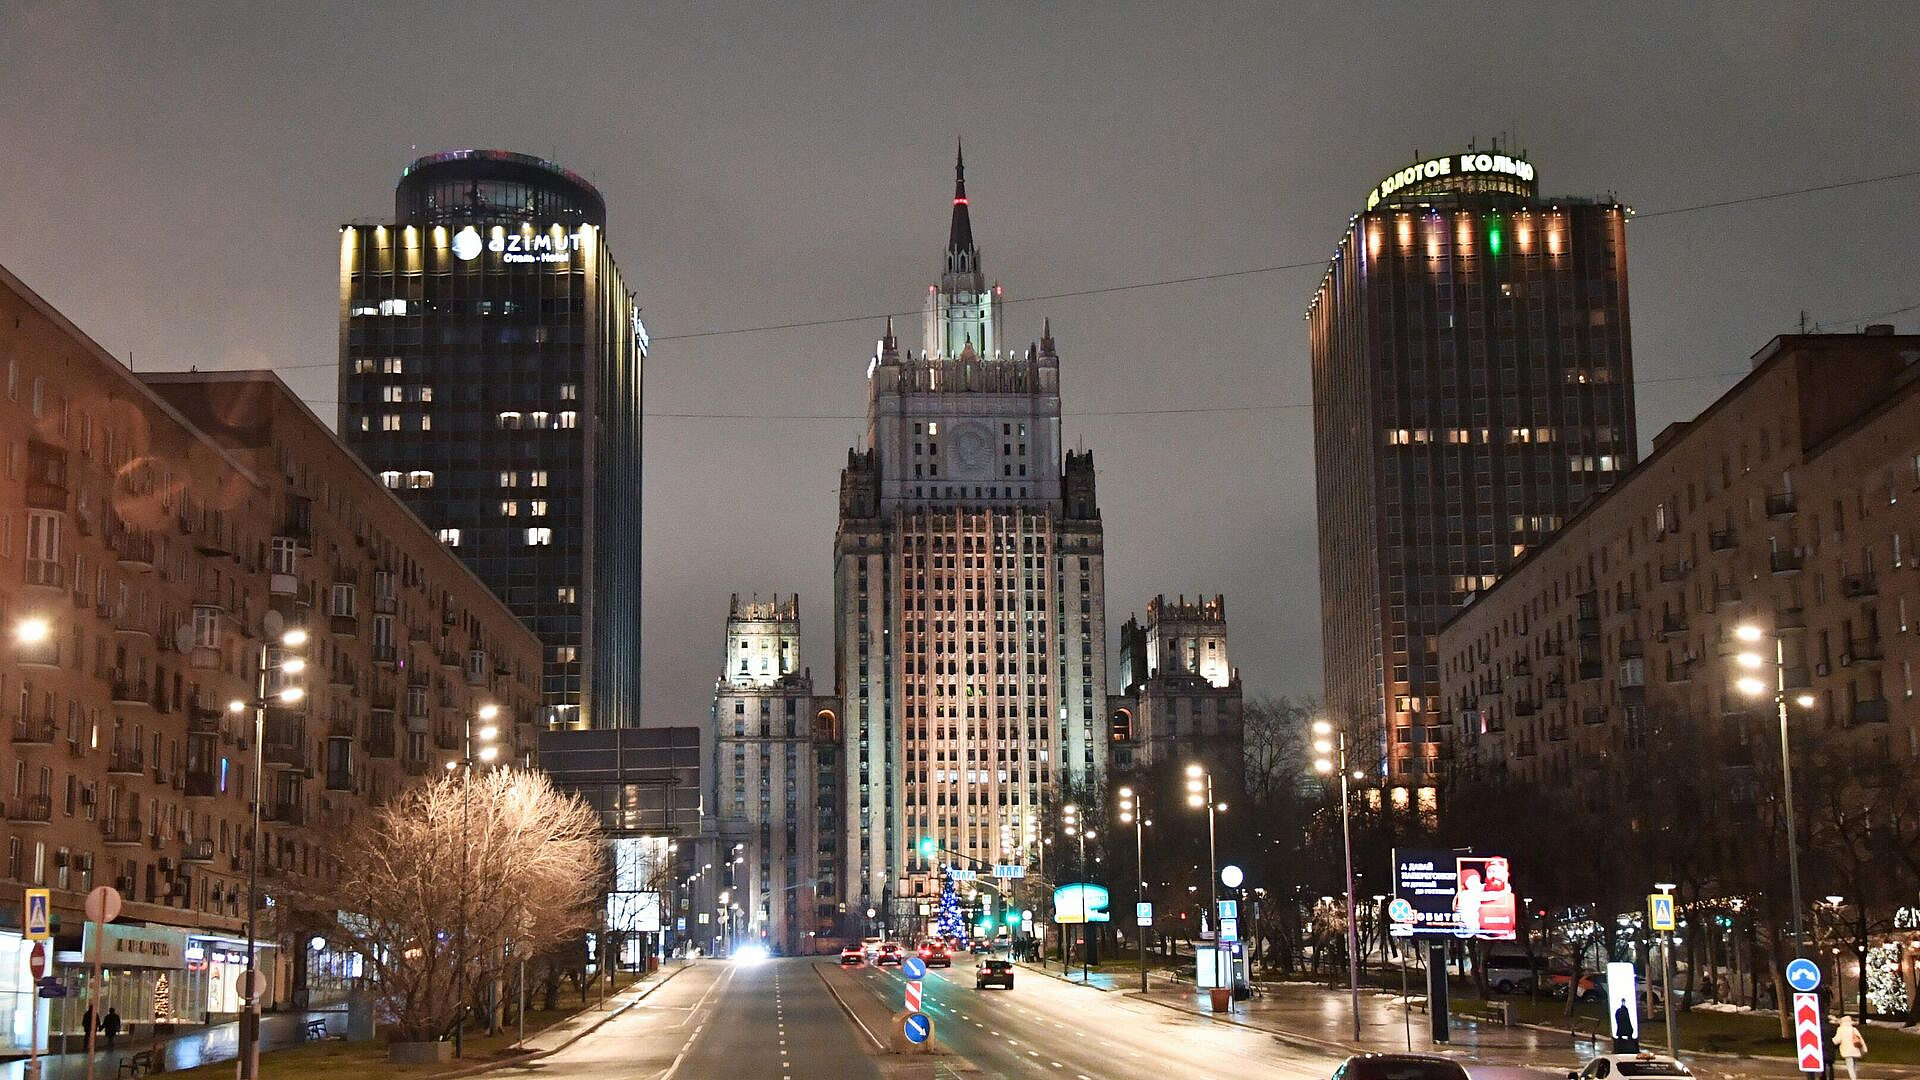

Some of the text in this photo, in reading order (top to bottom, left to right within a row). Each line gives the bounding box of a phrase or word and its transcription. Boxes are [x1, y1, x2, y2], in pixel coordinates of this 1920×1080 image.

[1381, 154, 1534, 197] ЗОЛОТОЕ КОЛЬЦО
[540, 252, 569, 263] Hotel
